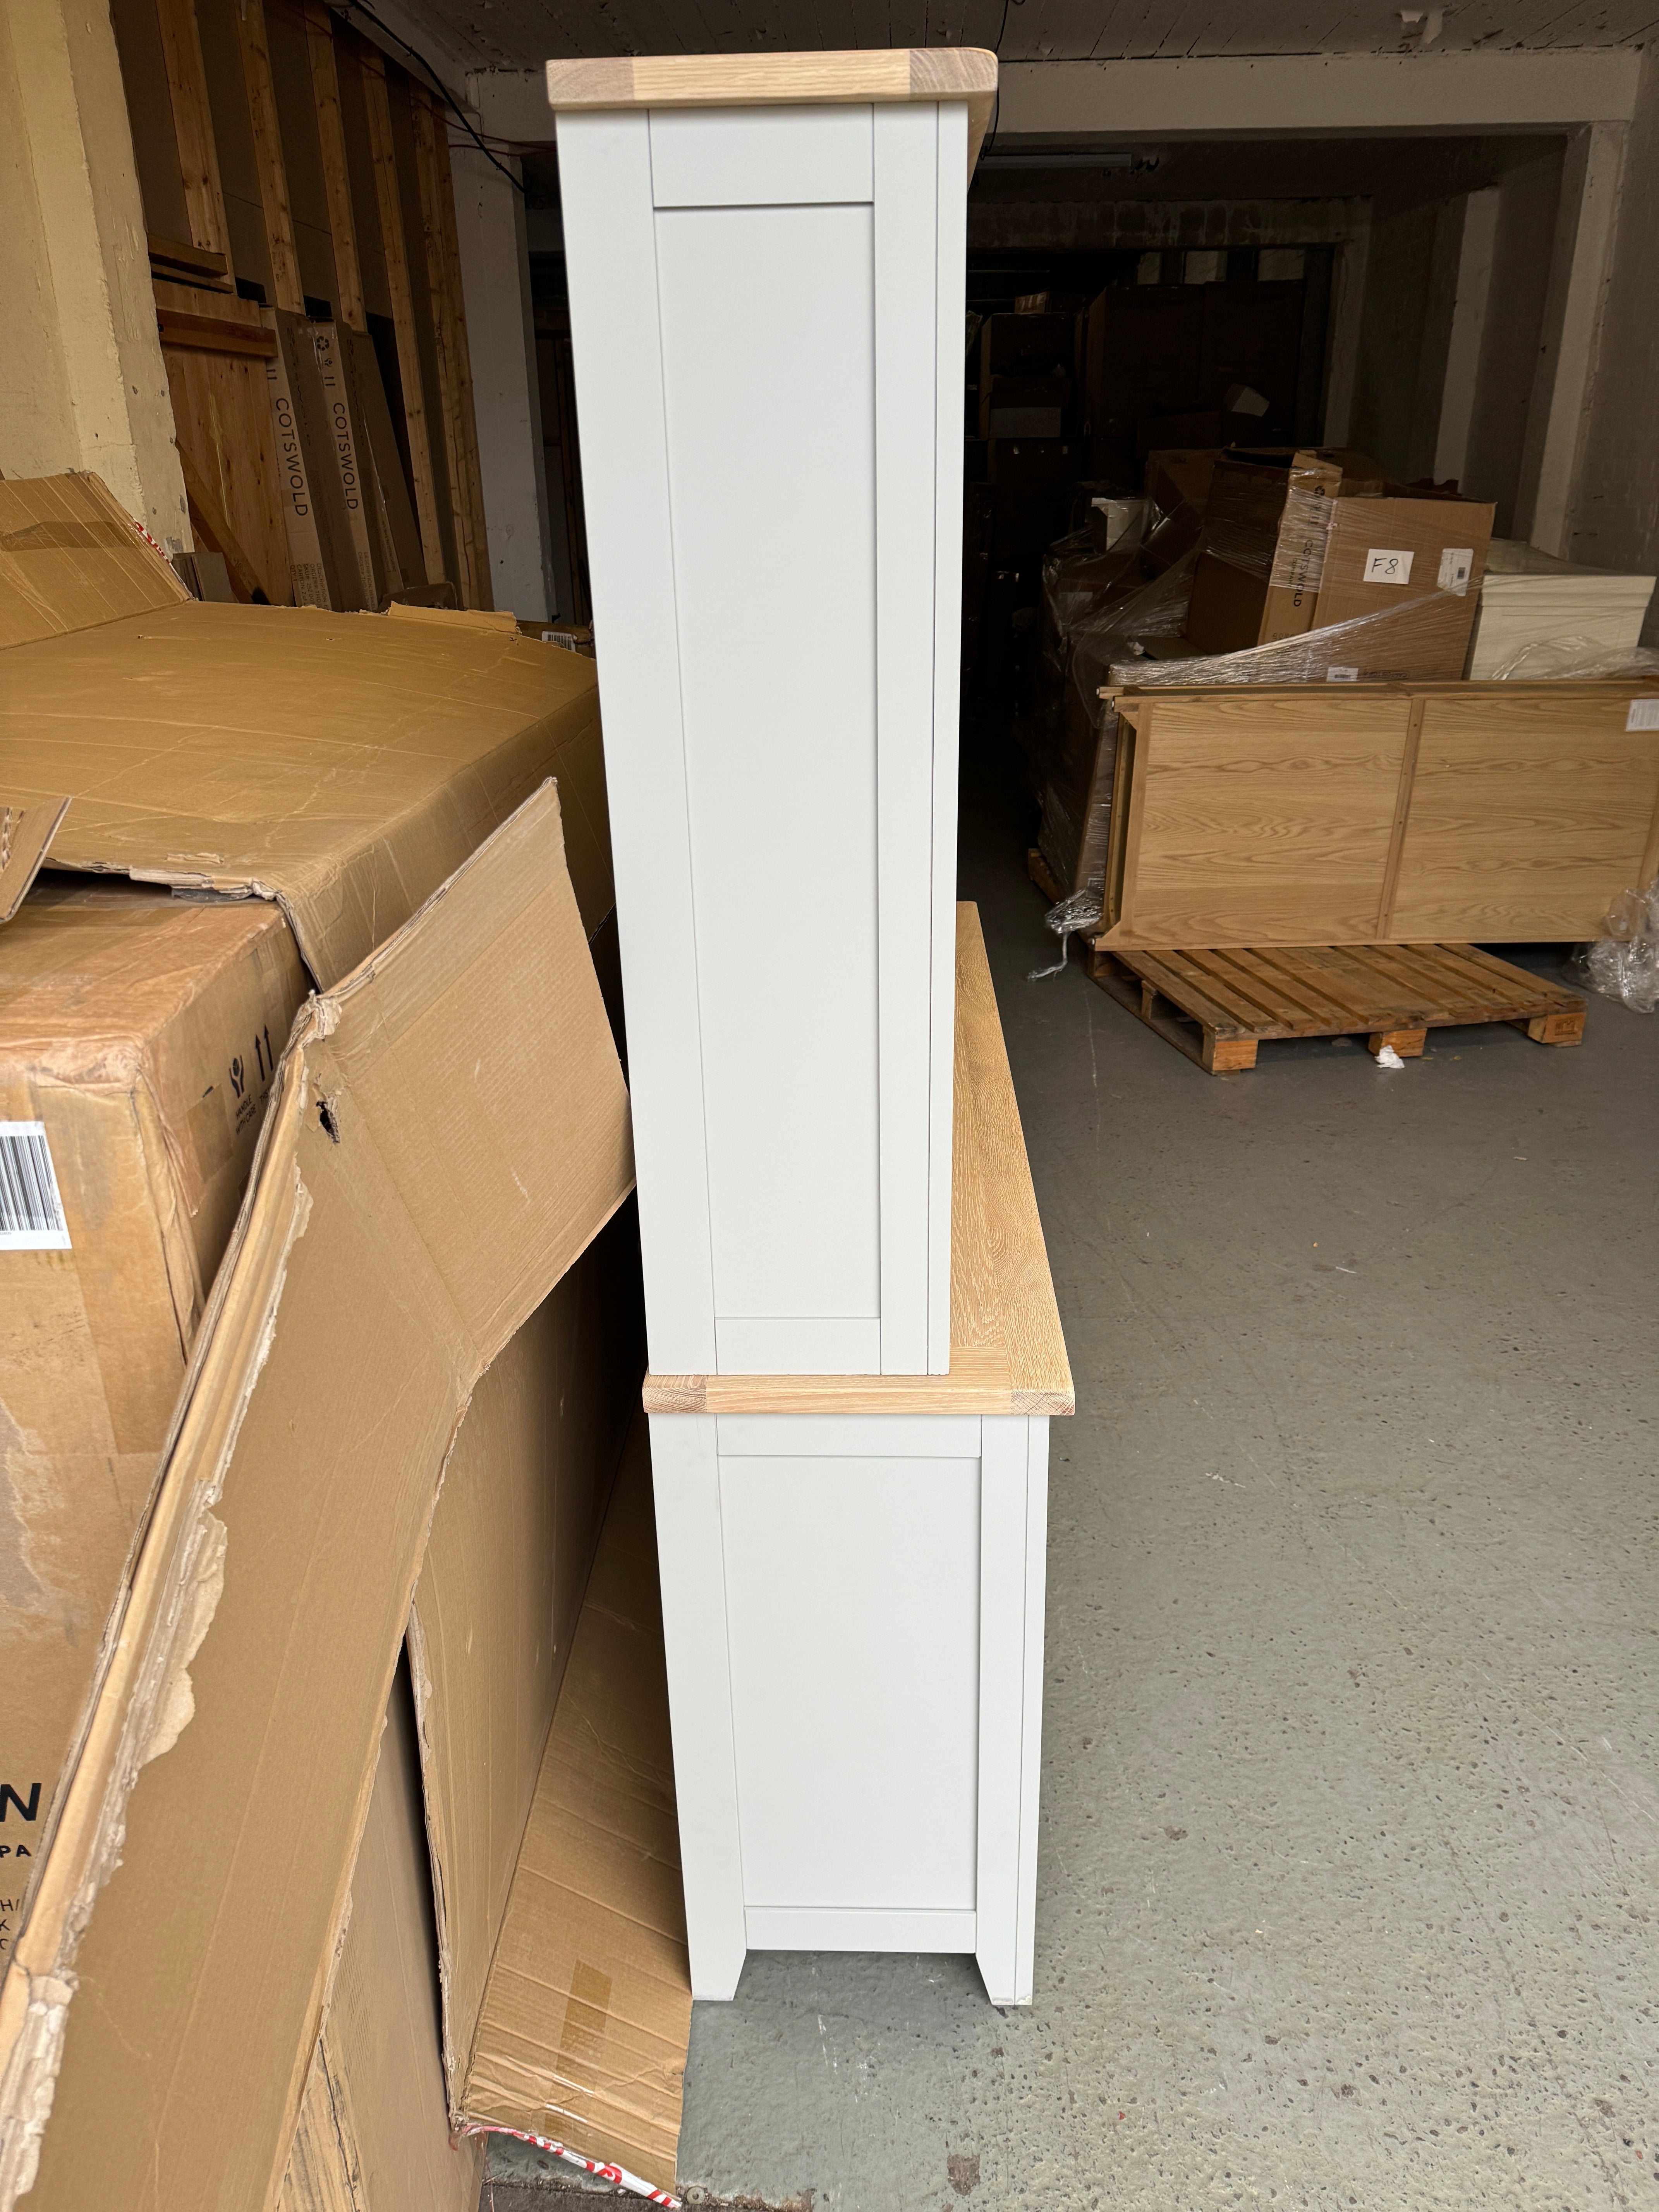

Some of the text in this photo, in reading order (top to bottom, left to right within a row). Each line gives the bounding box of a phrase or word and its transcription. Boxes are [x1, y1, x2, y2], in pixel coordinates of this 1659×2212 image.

[276, 398, 308, 516] COTSWOLD
[333, 402, 358, 509] COTSWOLD
[1293, 539, 1313, 607] COTSWOLD
[1371, 558, 1399, 574] F8
